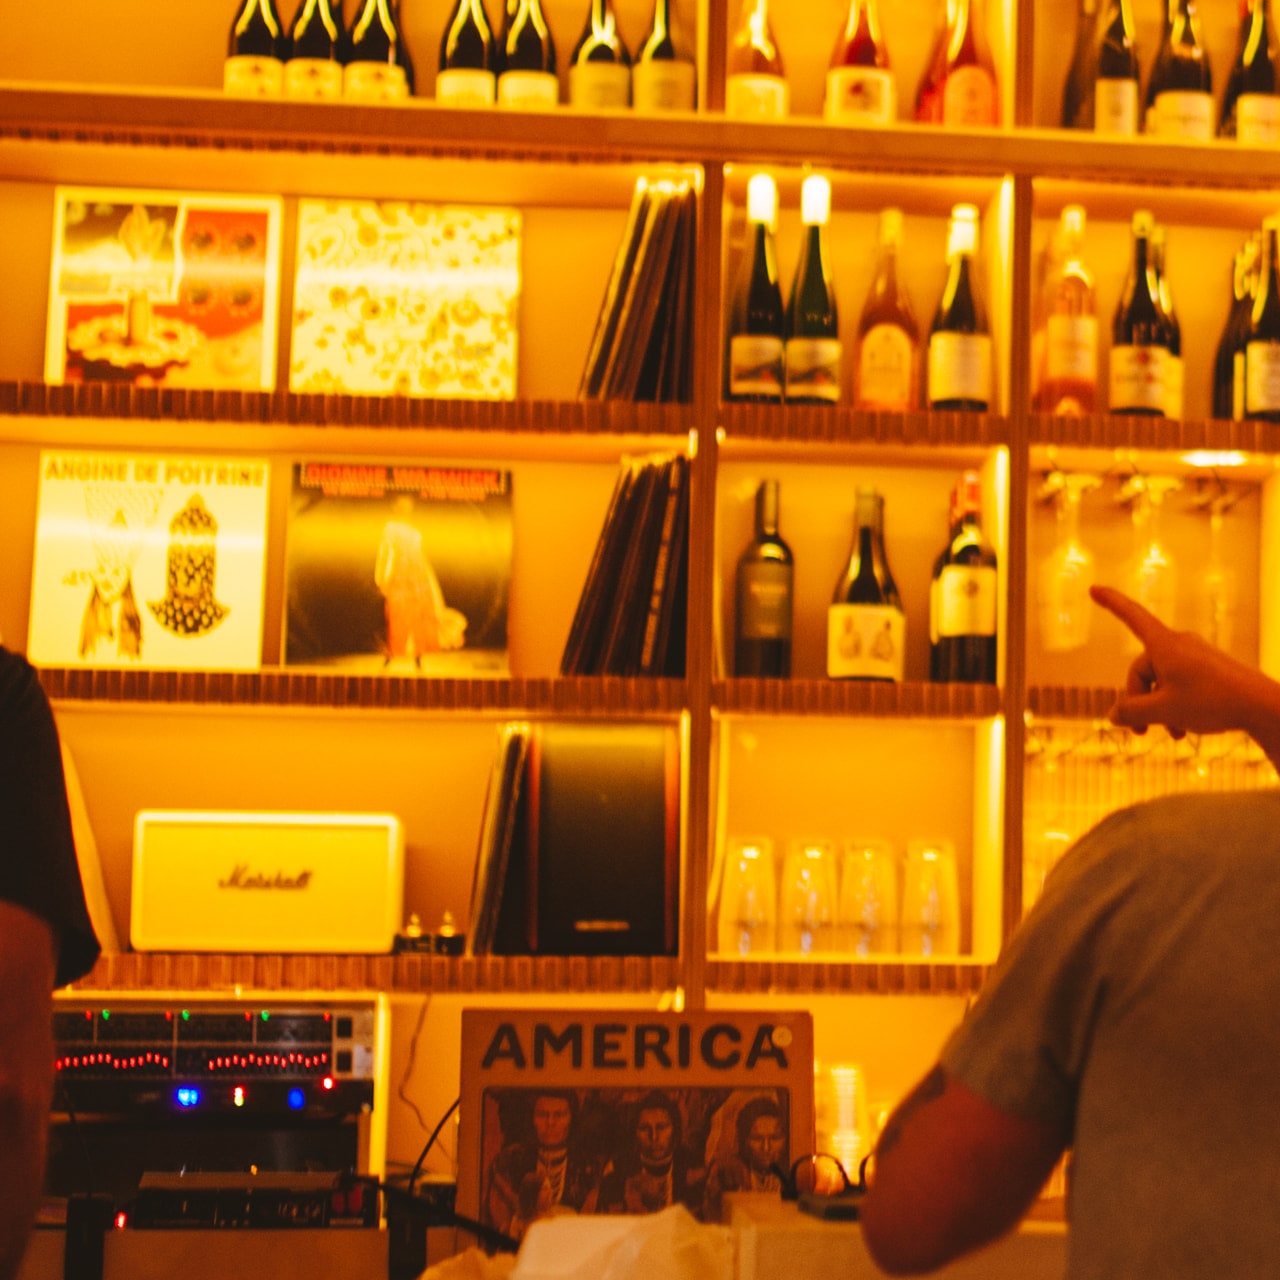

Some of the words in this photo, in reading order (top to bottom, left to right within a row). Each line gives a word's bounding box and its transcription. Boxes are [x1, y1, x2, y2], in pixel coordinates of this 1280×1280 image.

[45, 460, 127, 481] ANGINE
[164, 463, 265, 486] POITRINE
[217, 862, 313, 891] Marshall
[481, 1023, 789, 1069] AMERICA
